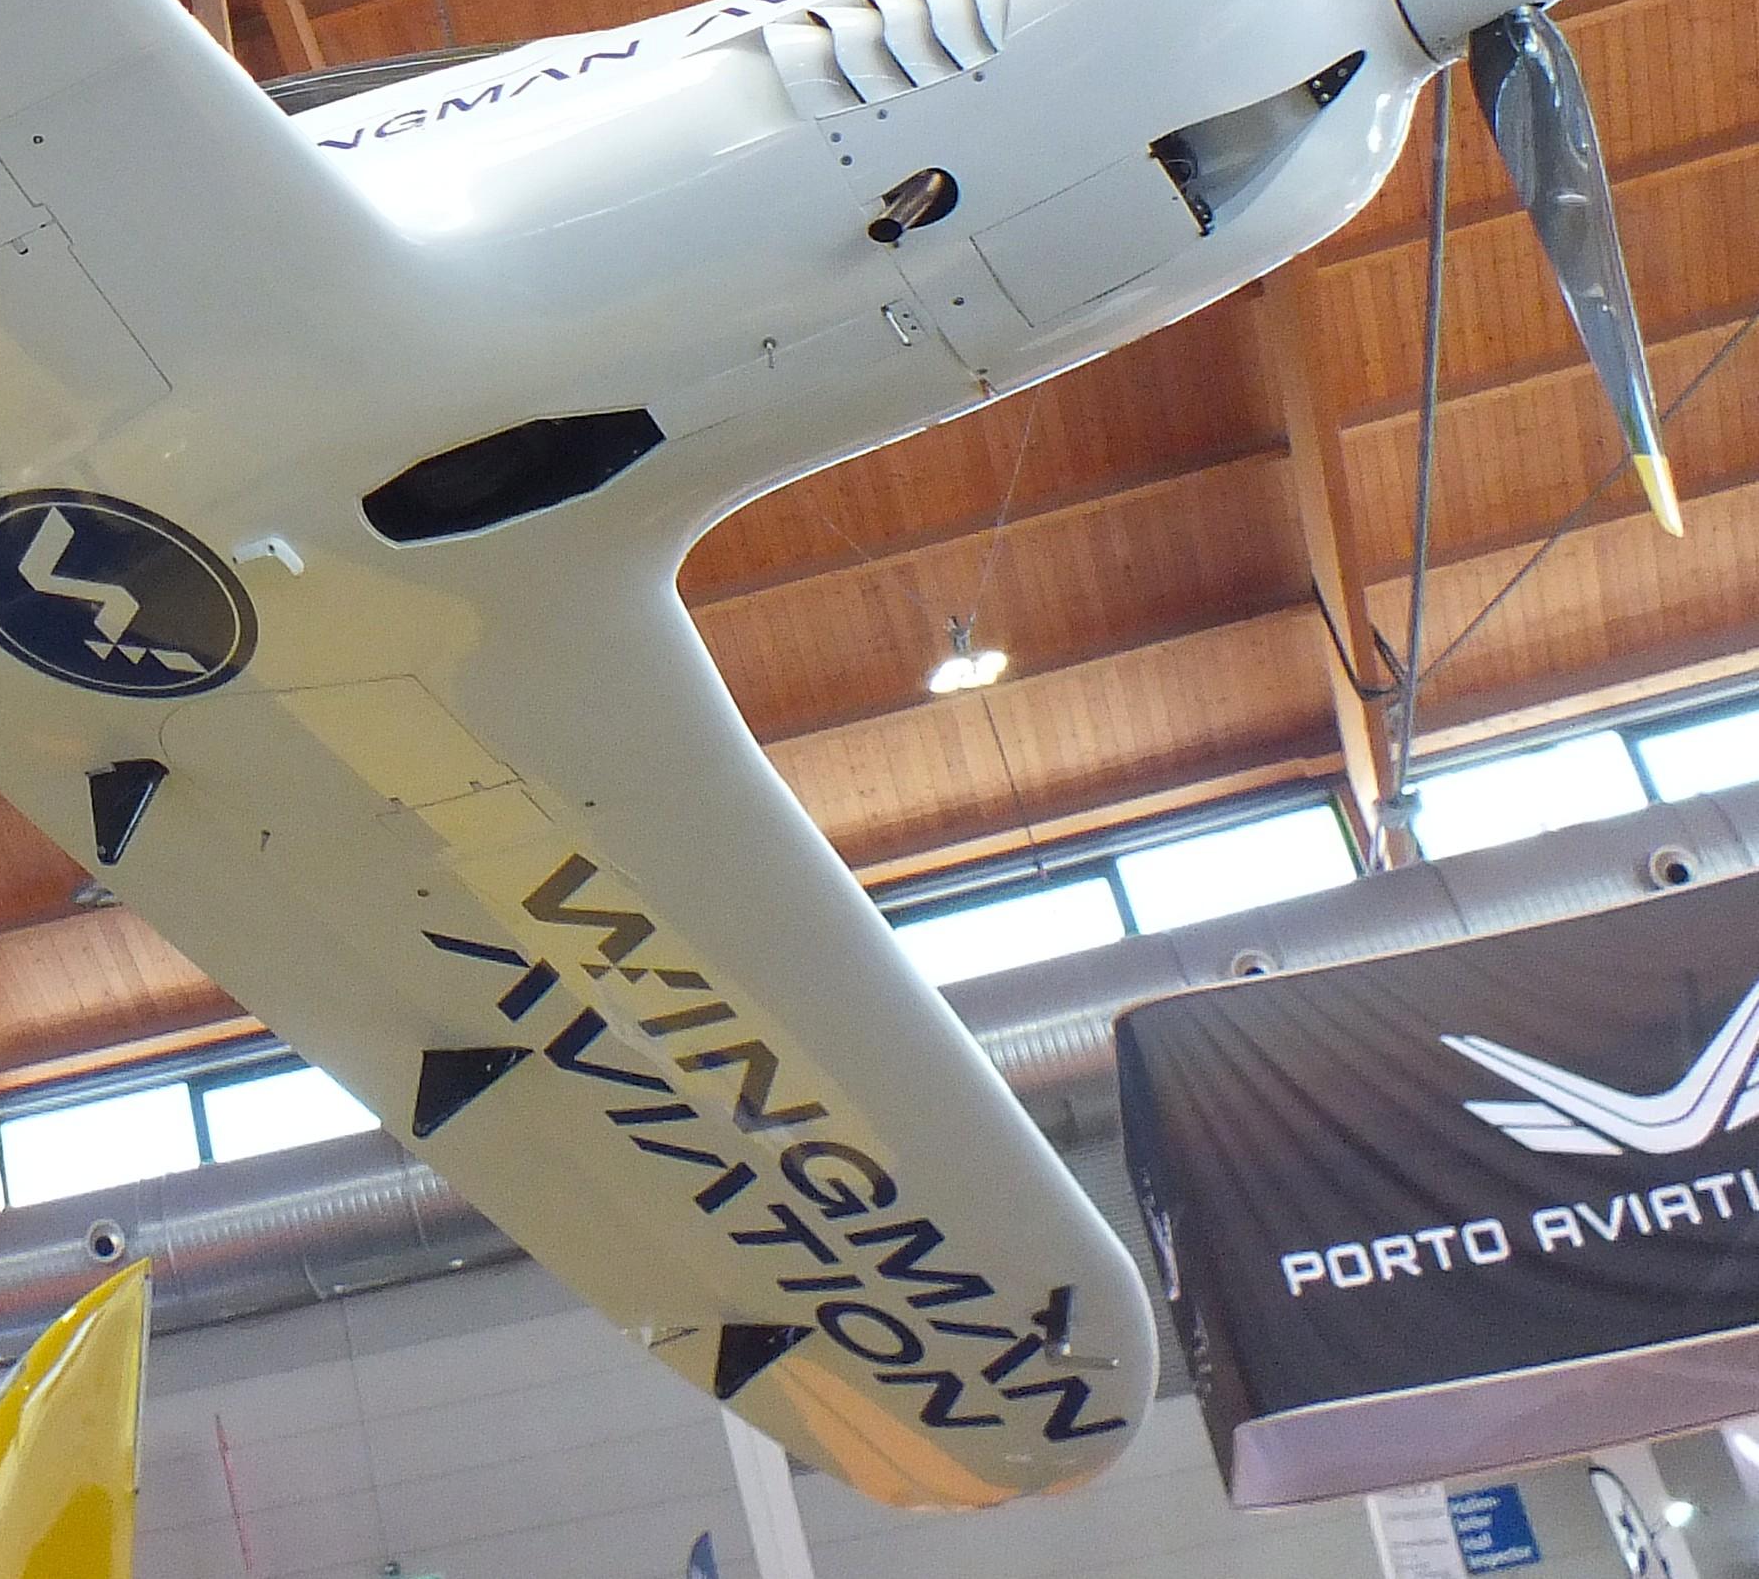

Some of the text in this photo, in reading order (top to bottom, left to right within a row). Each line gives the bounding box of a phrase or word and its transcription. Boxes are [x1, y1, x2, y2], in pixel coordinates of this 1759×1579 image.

[421, 930, 1004, 1428] AVIATION
[522, 853, 1128, 1442] WINGMAN
[1280, 1218, 1511, 1297] PORTO
